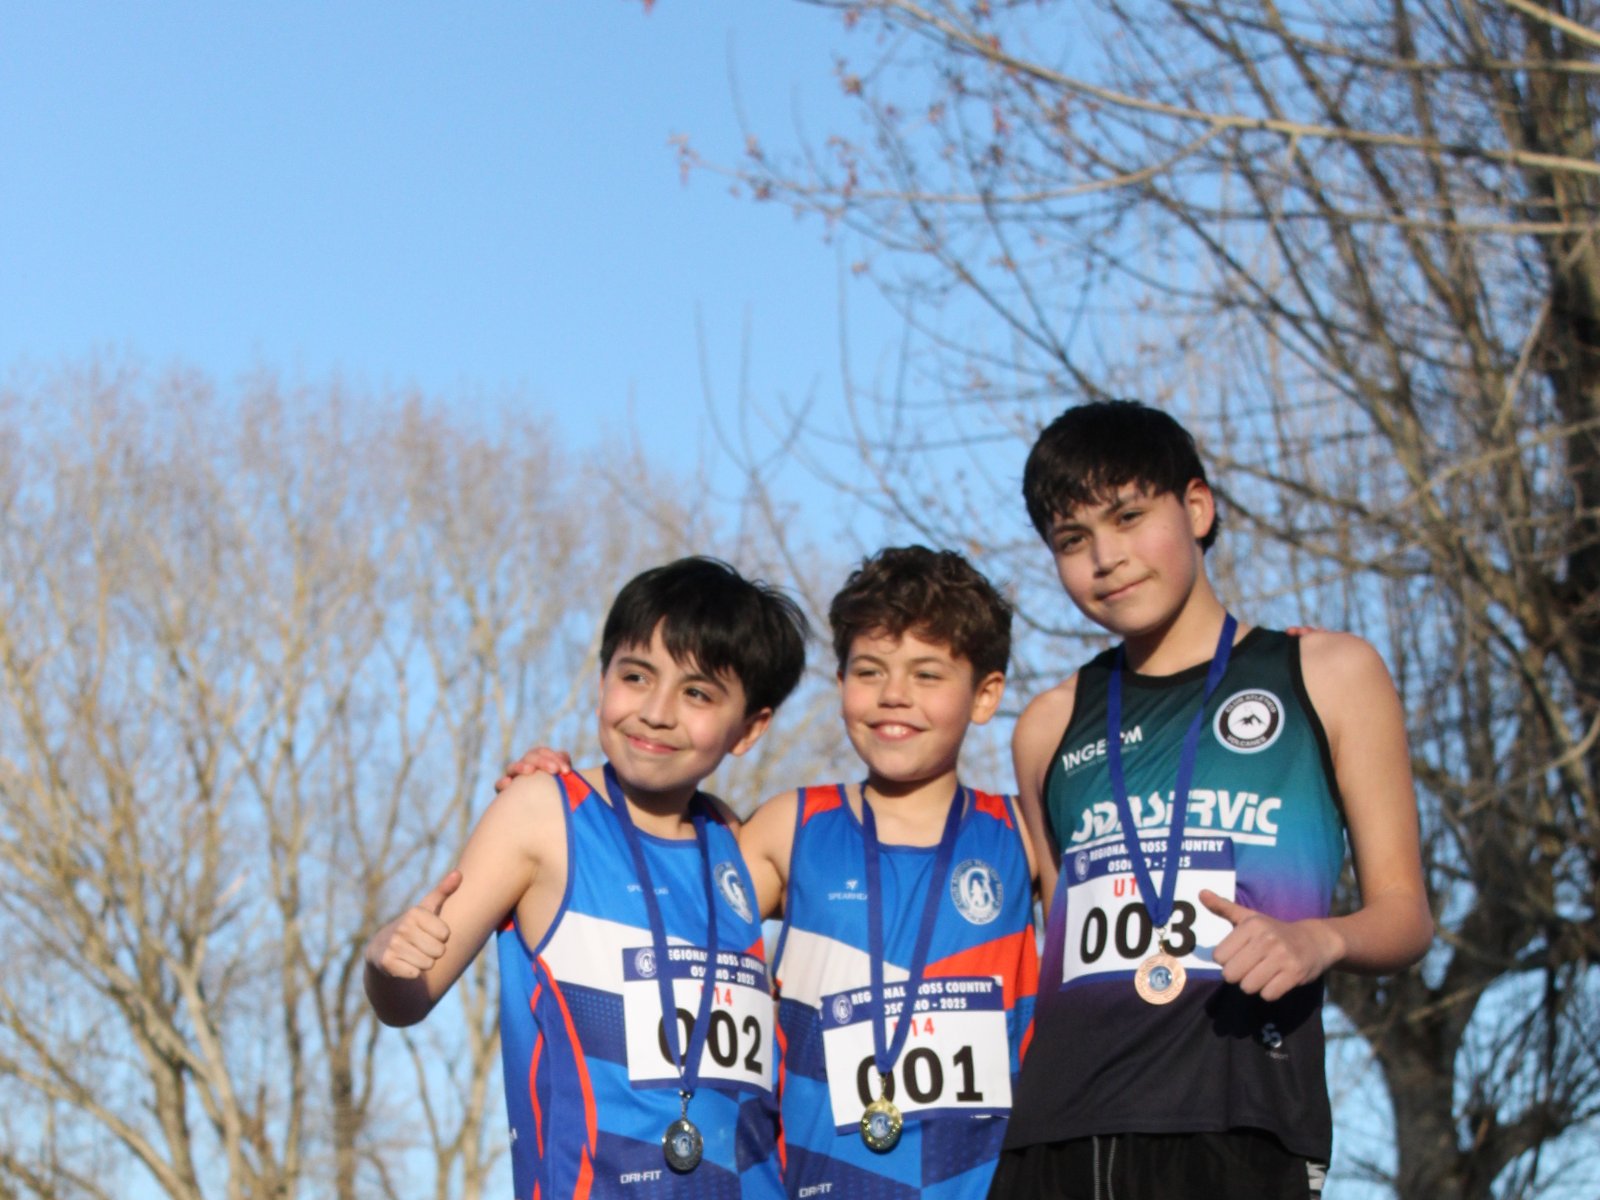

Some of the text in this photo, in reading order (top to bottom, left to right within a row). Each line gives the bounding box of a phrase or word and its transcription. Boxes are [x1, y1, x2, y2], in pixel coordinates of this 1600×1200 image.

[1089, 843, 1129, 861] REGIONA
[1140, 841, 1168, 853] ROSS
[1080, 900, 1197, 964] 003
[716, 953, 739, 967] ROSS
[851, 985, 906, 1006] REGNAL
[945, 980, 993, 994] COUNTRY
[940, 997, 967, 1010] 2025
[658, 1007, 763, 1075] 002
[856, 1045, 984, 1112] 001
